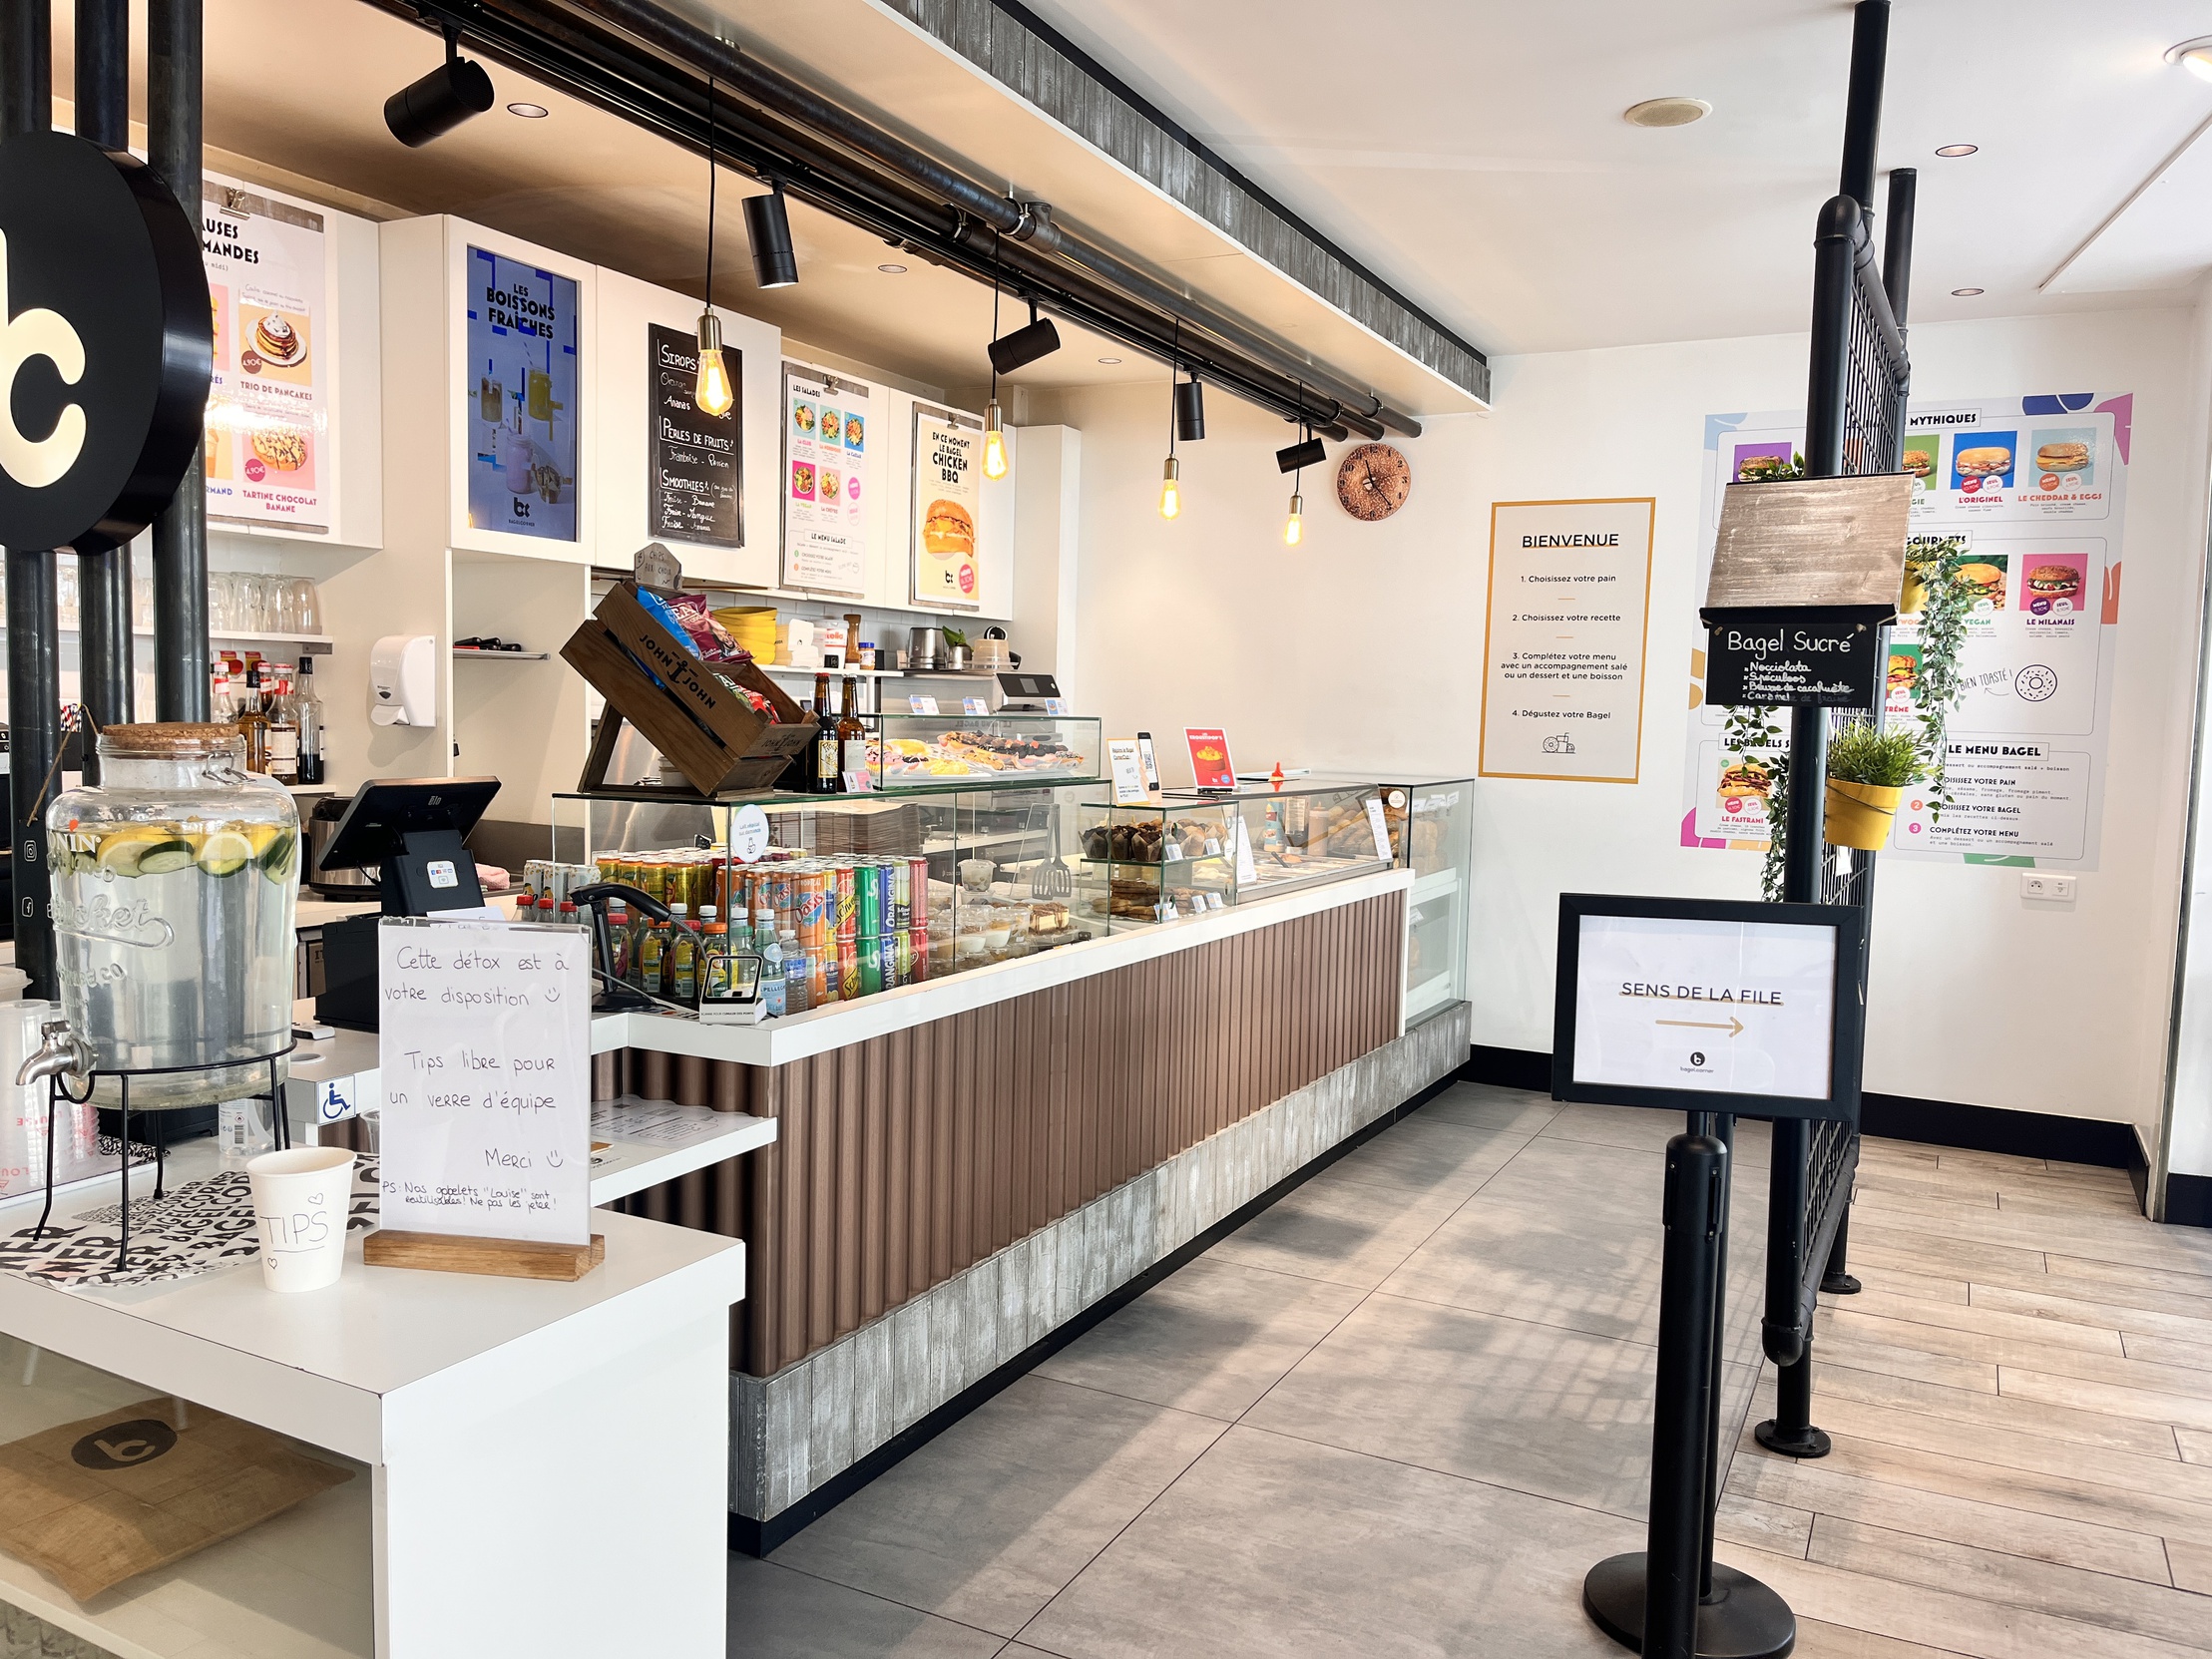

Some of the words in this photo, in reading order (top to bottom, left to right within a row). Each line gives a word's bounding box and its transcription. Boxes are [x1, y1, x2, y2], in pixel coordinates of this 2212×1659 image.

[513, 283, 529, 297] LES
[486, 286, 556, 321] BOISSONS
[240, 380, 260, 392] TRIO
[261, 385, 272, 394] DE
[274, 387, 313, 401] PANCAKES
[1910, 413, 1977, 426] MYTHIQUES
[663, 418, 690, 441] PERLES
[692, 432, 702, 445] DE
[940, 434, 948, 443] CE
[932, 452, 968, 471] CHICKEN
[941, 468, 959, 484] BBQ
[242, 490, 274, 502] TARTINE
[275, 494, 317, 506] CHOCOLAT
[265, 503, 296, 513] BANANE
[1522, 534, 1619, 548] BIENVENUE
[1597, 575, 1616, 584] pain
[1727, 628, 1784, 660] Bagel
[1793, 631, 1855, 652] Sucré
[1522, 652, 1566, 661] Complétez
[639, 634, 673, 667] JOHN
[681, 676, 716, 709] JOHN
[1534, 662, 1608, 671] accompagnement
[1749, 659, 1812, 673] Nocciolata
[1979, 667, 2007, 686] TOASTÉ
[1522, 709, 1560, 718] Dégustez
[1586, 711, 1610, 720] Bagel
[1948, 744, 1963, 753] LE
[1965, 745, 1998, 755] MENU
[2001, 746, 2041, 756] BAGEL
[1974, 777, 1997, 786] VOTRE
[1929, 825, 1973, 835] COMPLÉTEZ
[397, 946, 442, 970] Cette
[453, 950, 500, 970] détox
[518, 953, 542, 971] est
[555, 953, 570, 971] à
[441, 987, 530, 1010] disposition
[1621, 983, 1670, 998] SENS
[1677, 986, 1702, 1000] DE
[1709, 988, 1733, 1002] LA
[1740, 990, 1782, 1005] FILE
[404, 1050, 444, 1074] Tips
[390, 1091, 408, 1104] un
[482, 1090, 557, 1115] d'équipe
[404, 1181, 427, 1194] Nos
[435, 1184, 479, 1198] gobelets
[531, 1189, 550, 1200] sont
[469, 1197, 484, 1207] Ne
[487, 1199, 503, 1212] pas
[509, 1199, 521, 1208] les
[259, 1210, 329, 1244] TIPS
